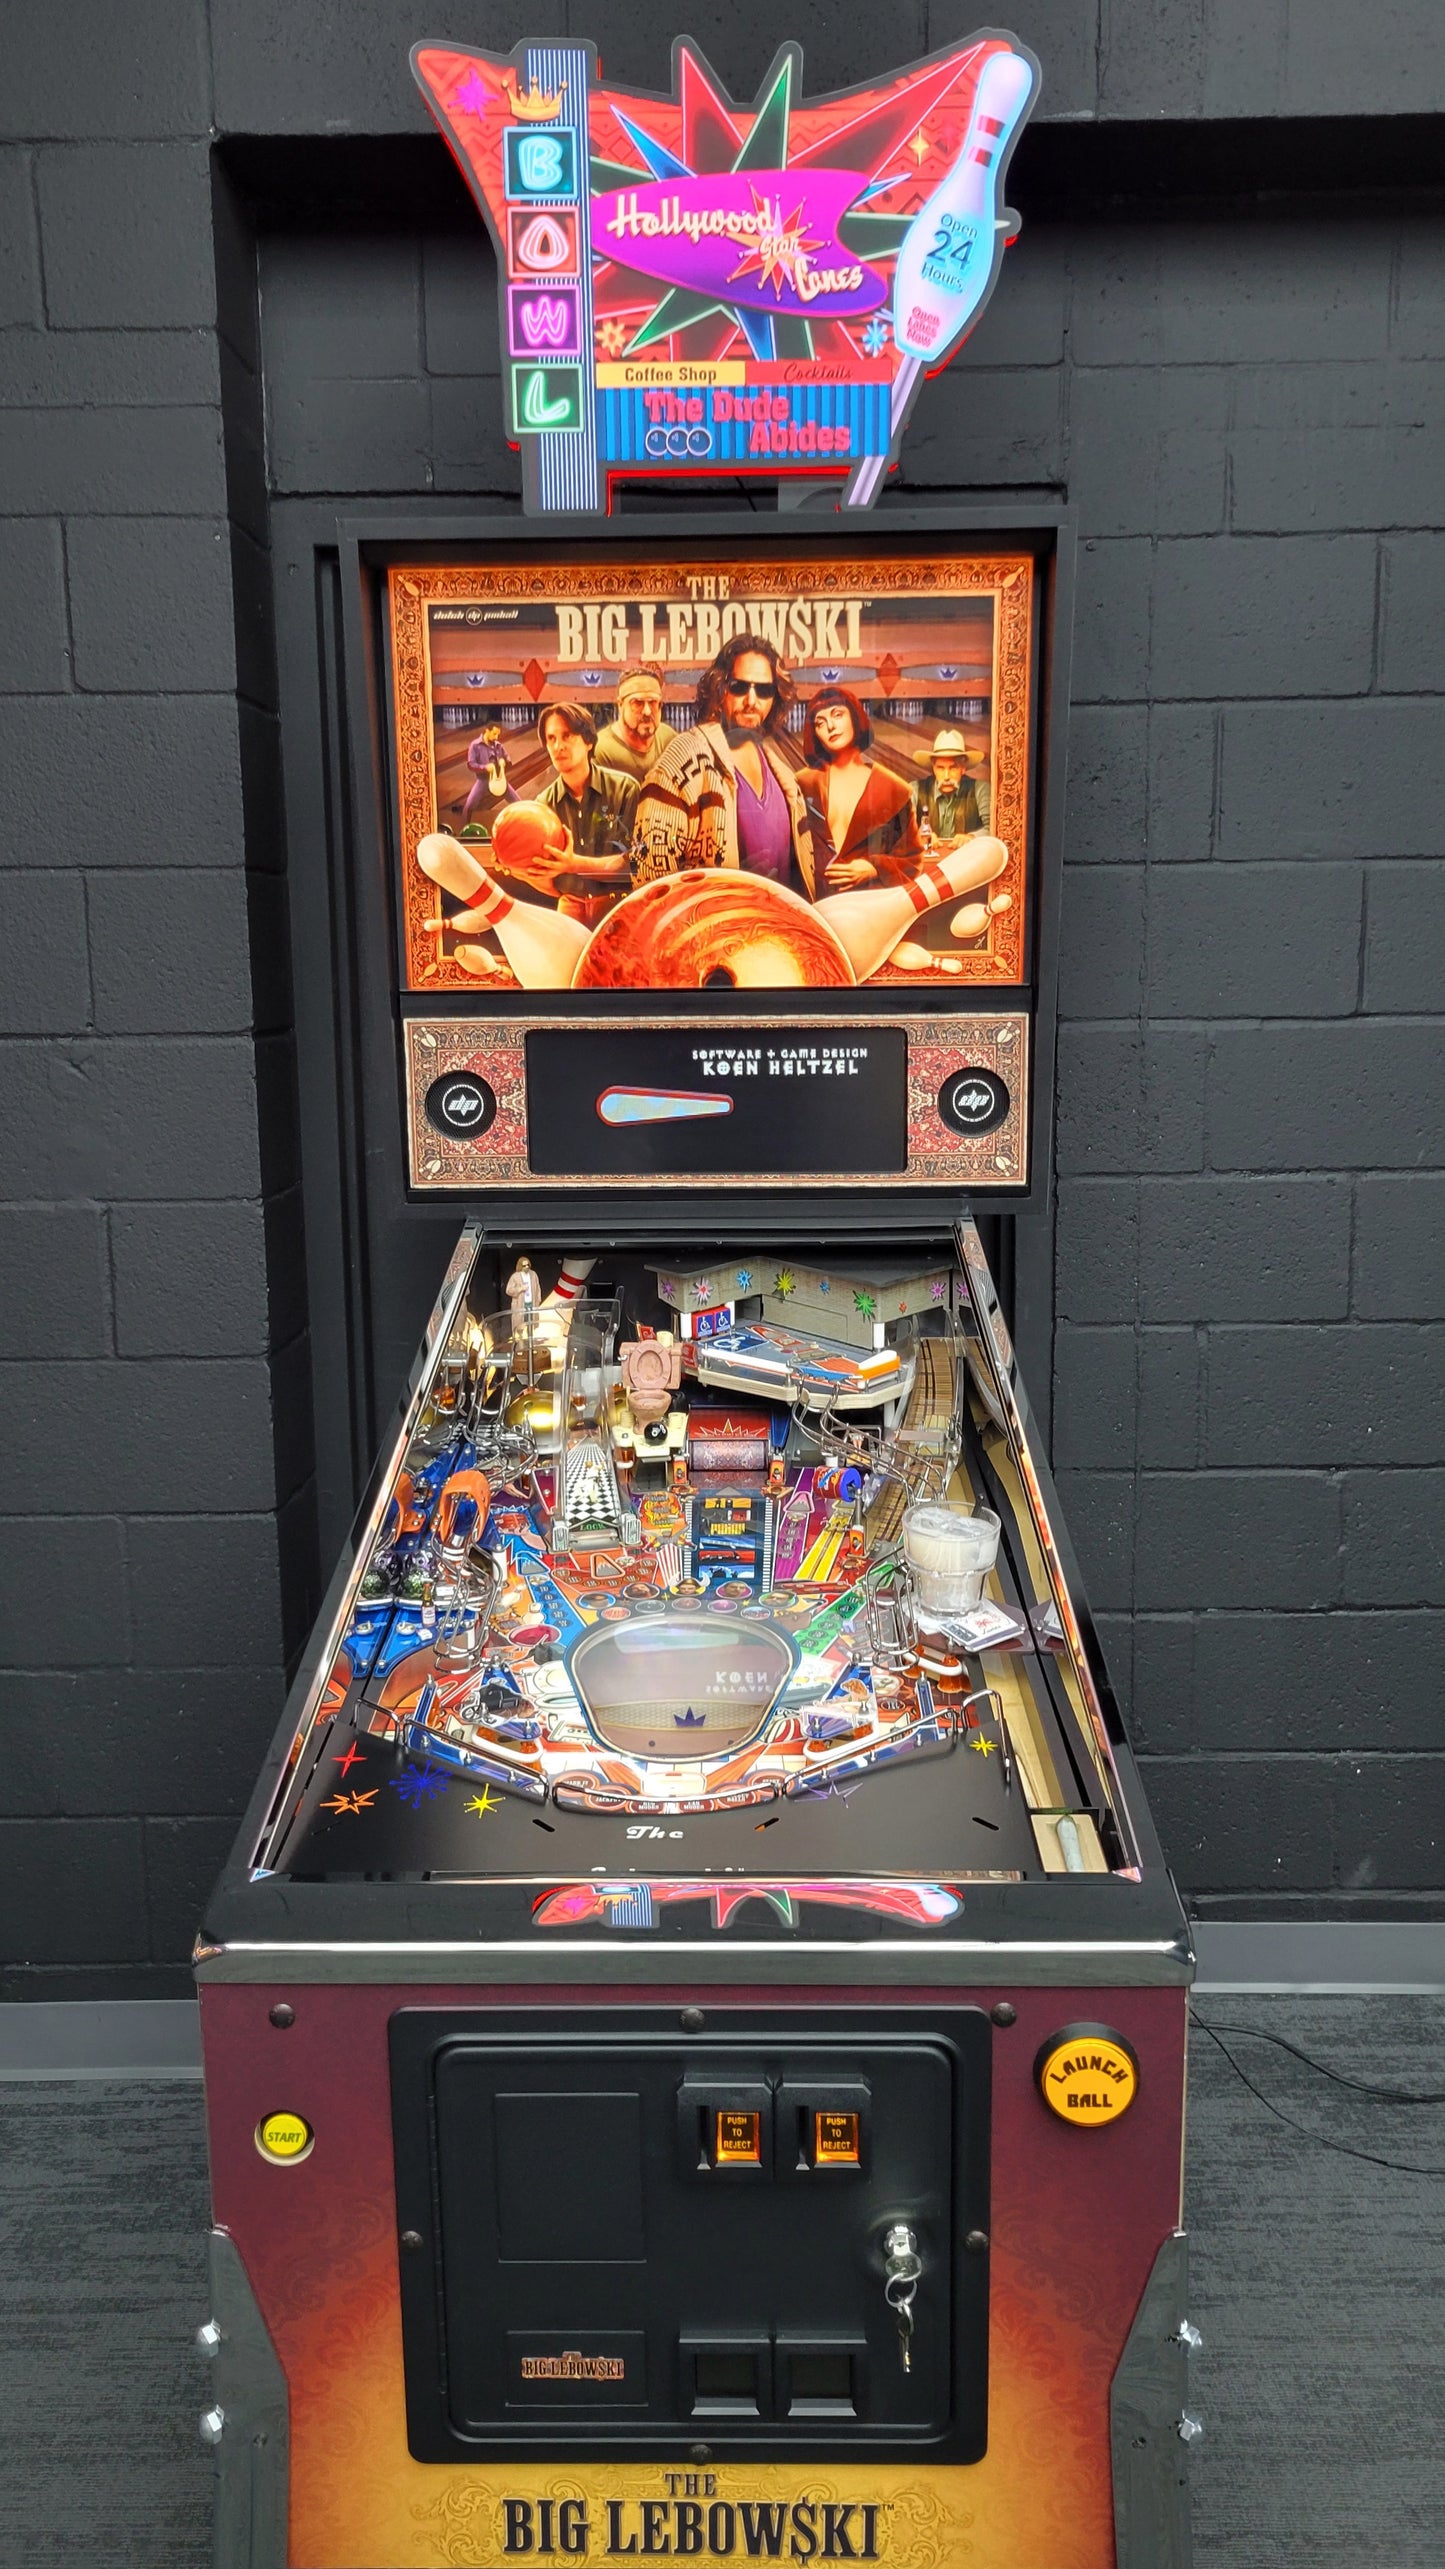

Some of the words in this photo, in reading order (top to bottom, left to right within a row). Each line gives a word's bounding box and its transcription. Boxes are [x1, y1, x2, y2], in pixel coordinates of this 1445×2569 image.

[606, 192, 777, 244] Hollywood
[940, 213, 978, 239] Open
[759, 235, 803, 260] Star
[926, 230, 974, 271] 24
[795, 255, 866, 302] Lanes
[921, 261, 963, 290] Hours
[906, 328, 932, 348] Now
[625, 366, 673, 383] Coffee
[679, 366, 717, 385] Shop
[783, 364, 854, 382] Cocktails
[644, 391, 704, 423] The
[713, 391, 790, 423] Dude
[749, 420, 851, 453] Abides
[687, 575, 731, 600] THE
[555, 604, 629, 663] BIG
[692, 1049, 762, 1060] SOFTWARE
[780, 1049, 817, 1060] GAME
[823, 1048, 868, 1059] DESIGN
[703, 1060, 759, 1076] KOEN
[769, 1059, 859, 1076] HELTZEL
[626, 1825, 684, 1839] The
[1049, 2055, 1129, 2084] LAUNCH
[1067, 2094, 1113, 2108] BALL
[727, 2117, 747, 2125] PUSH
[826, 2117, 847, 2126] PUSH
[267, 2132, 302, 2143] START
[732, 2128, 743, 2136] TO
[723, 2141, 751, 2149] REJECT
[823, 2141, 851, 2150] REJECT
[526, 2361, 547, 2376] BIG
[664, 2473, 718, 2496] THE
[502, 2499, 590, 2555] BIG
